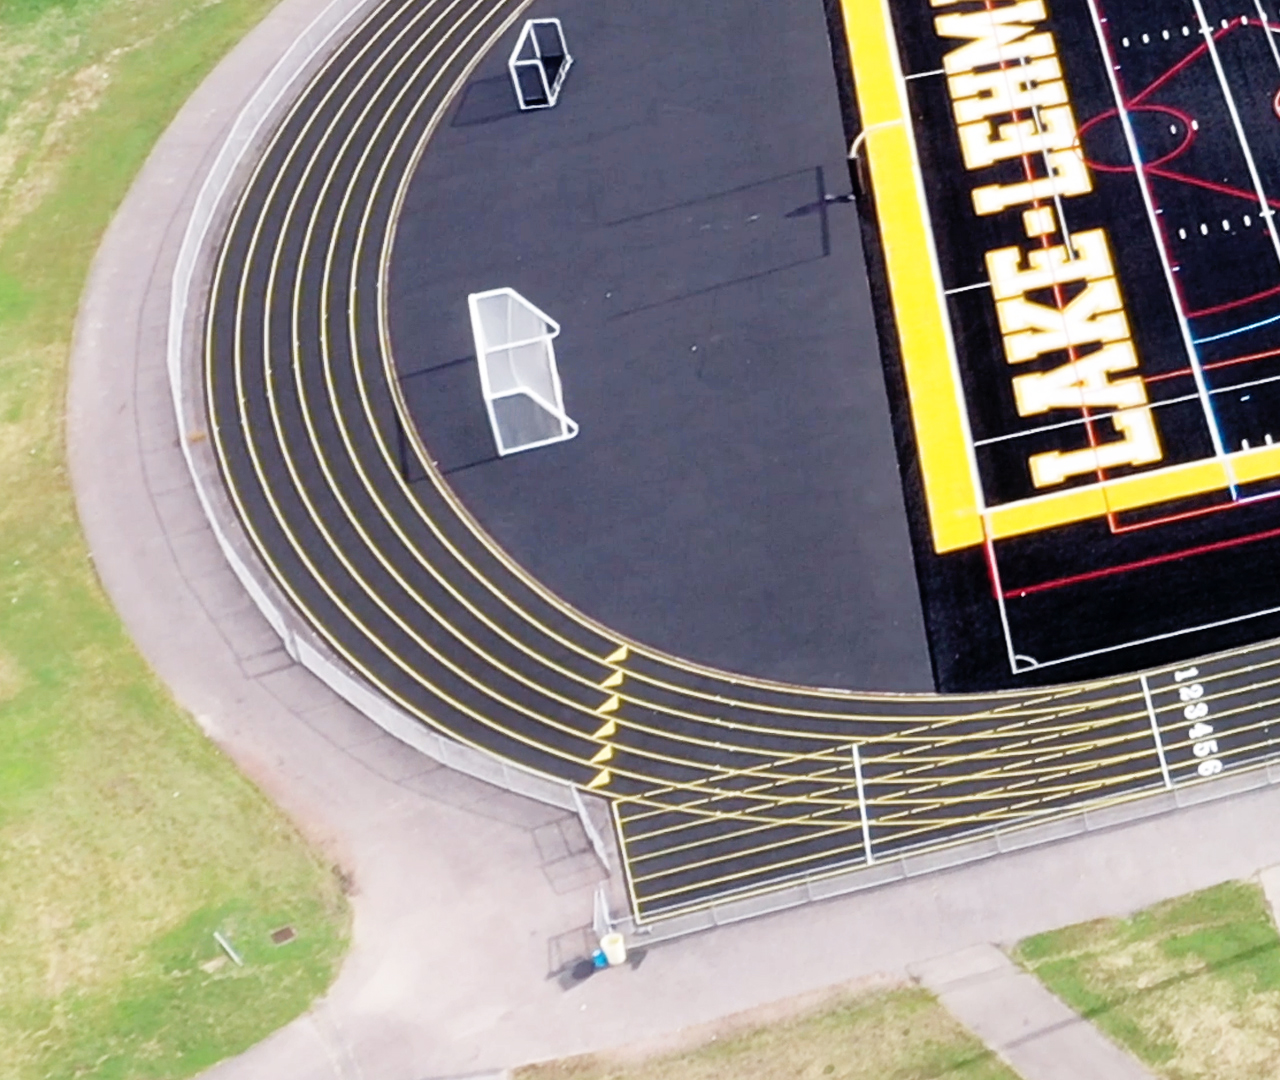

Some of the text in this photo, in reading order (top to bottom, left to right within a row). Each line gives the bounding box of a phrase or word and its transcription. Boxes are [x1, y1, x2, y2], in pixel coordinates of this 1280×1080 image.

[1174, 666, 1224, 777] 1 2 3 4 5 6
